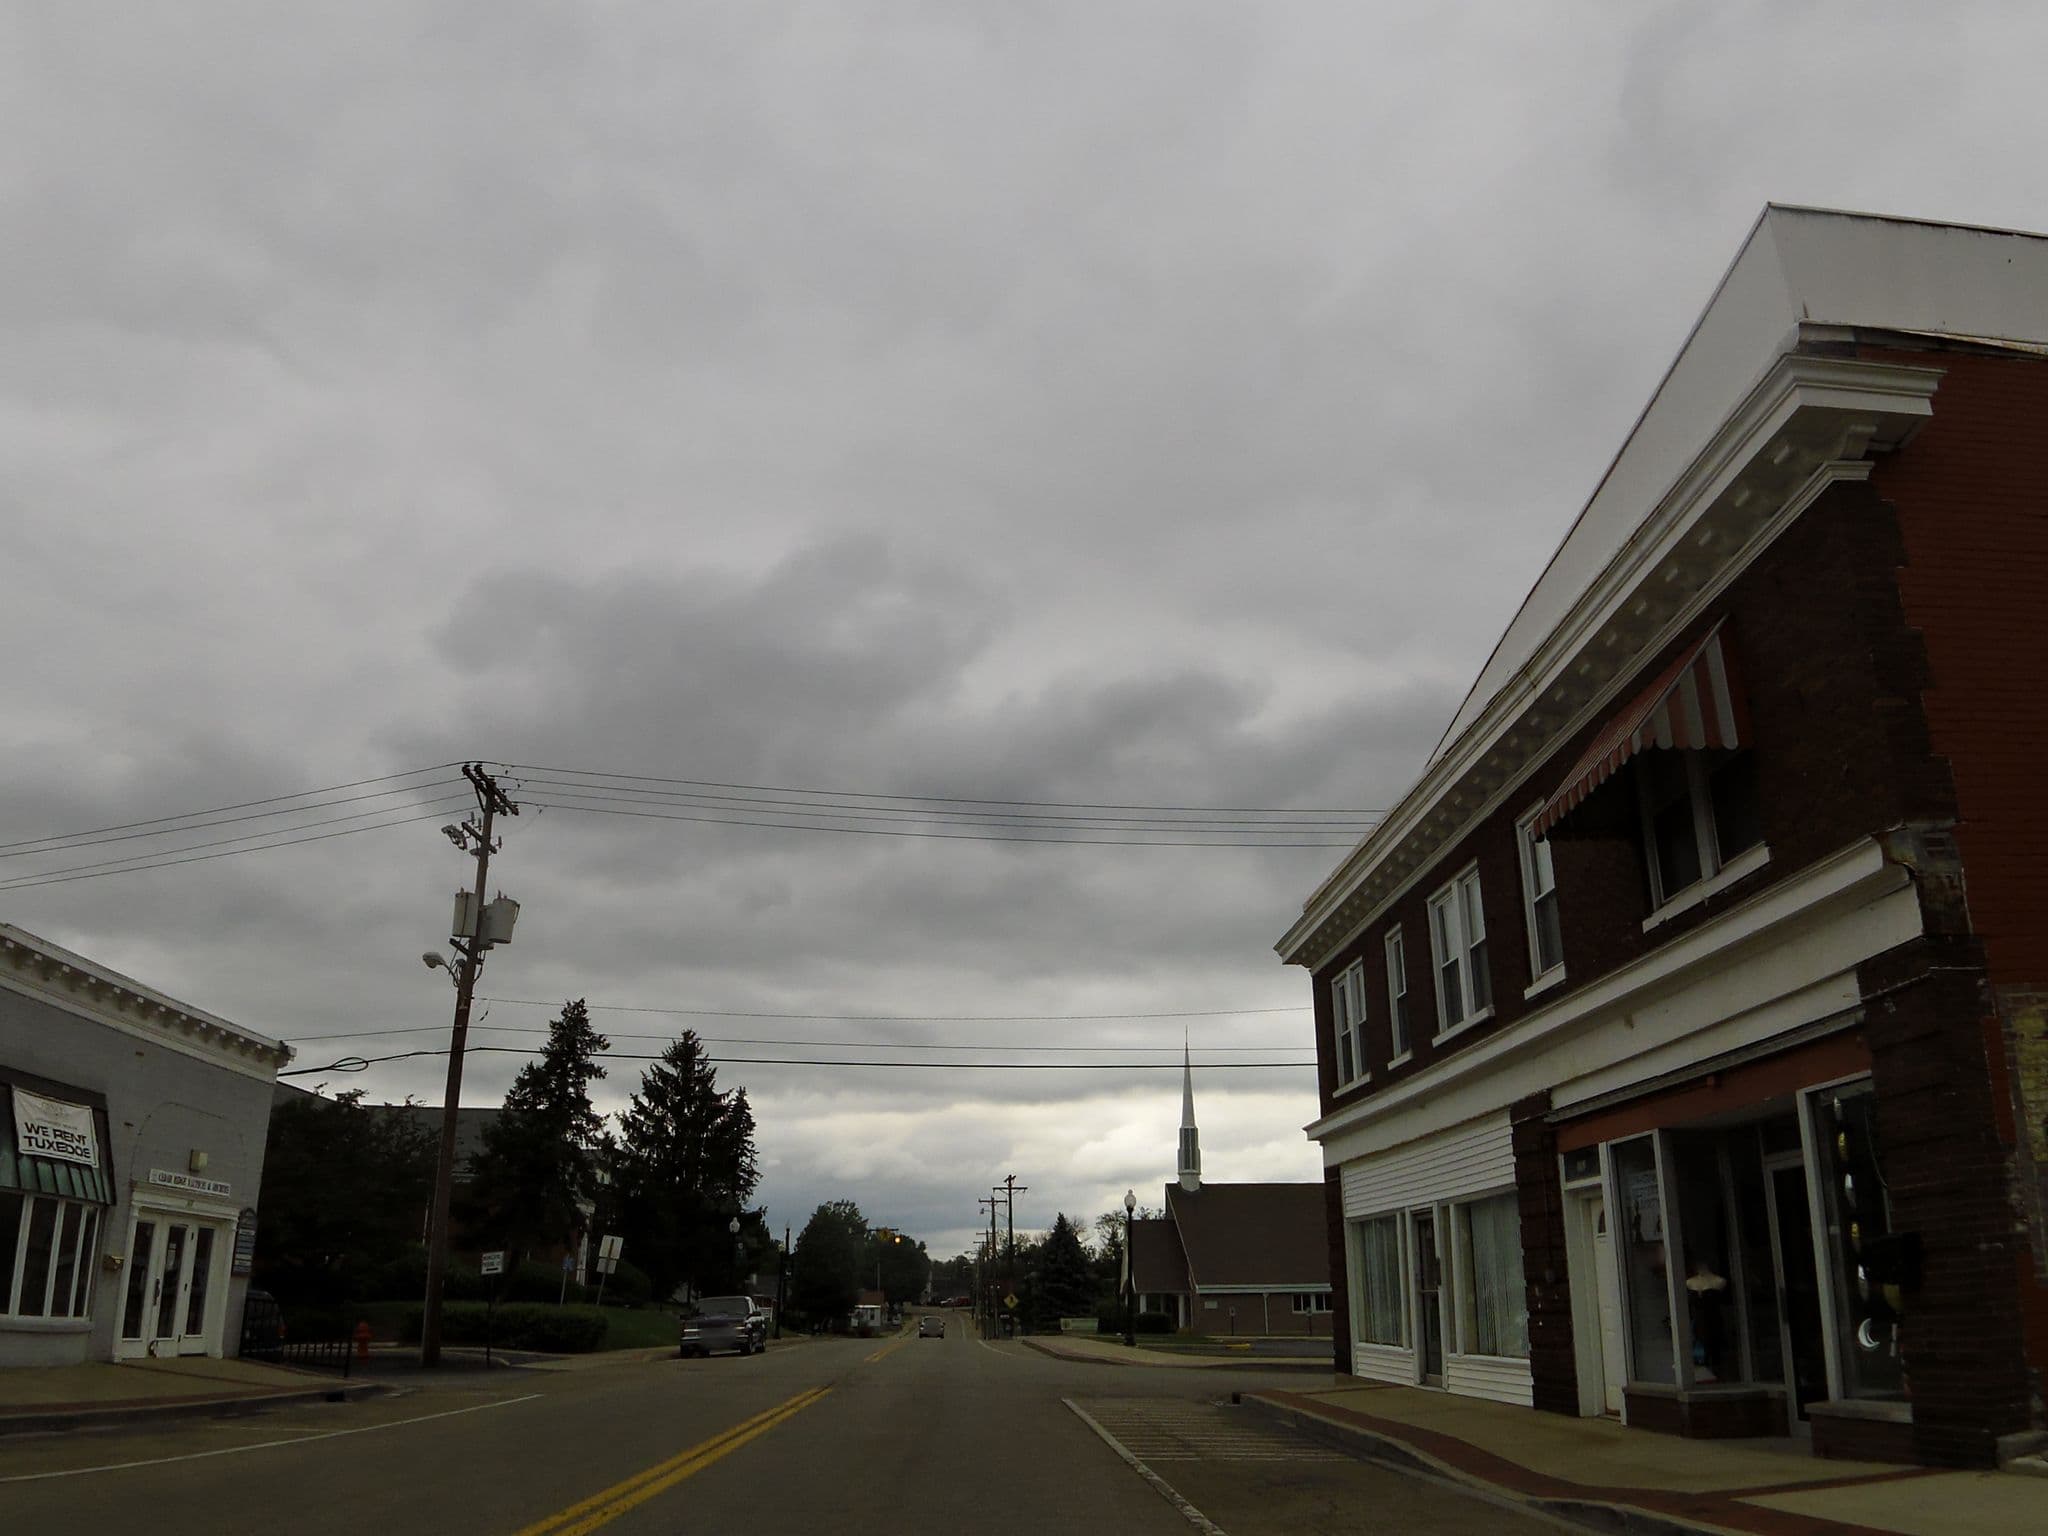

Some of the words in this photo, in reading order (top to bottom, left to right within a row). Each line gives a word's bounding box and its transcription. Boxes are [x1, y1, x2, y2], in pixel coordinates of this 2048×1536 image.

[24, 1121, 49, 1137] WE
[53, 1128, 87, 1146] RENT
[23, 1135, 91, 1159] TUXEDOS
